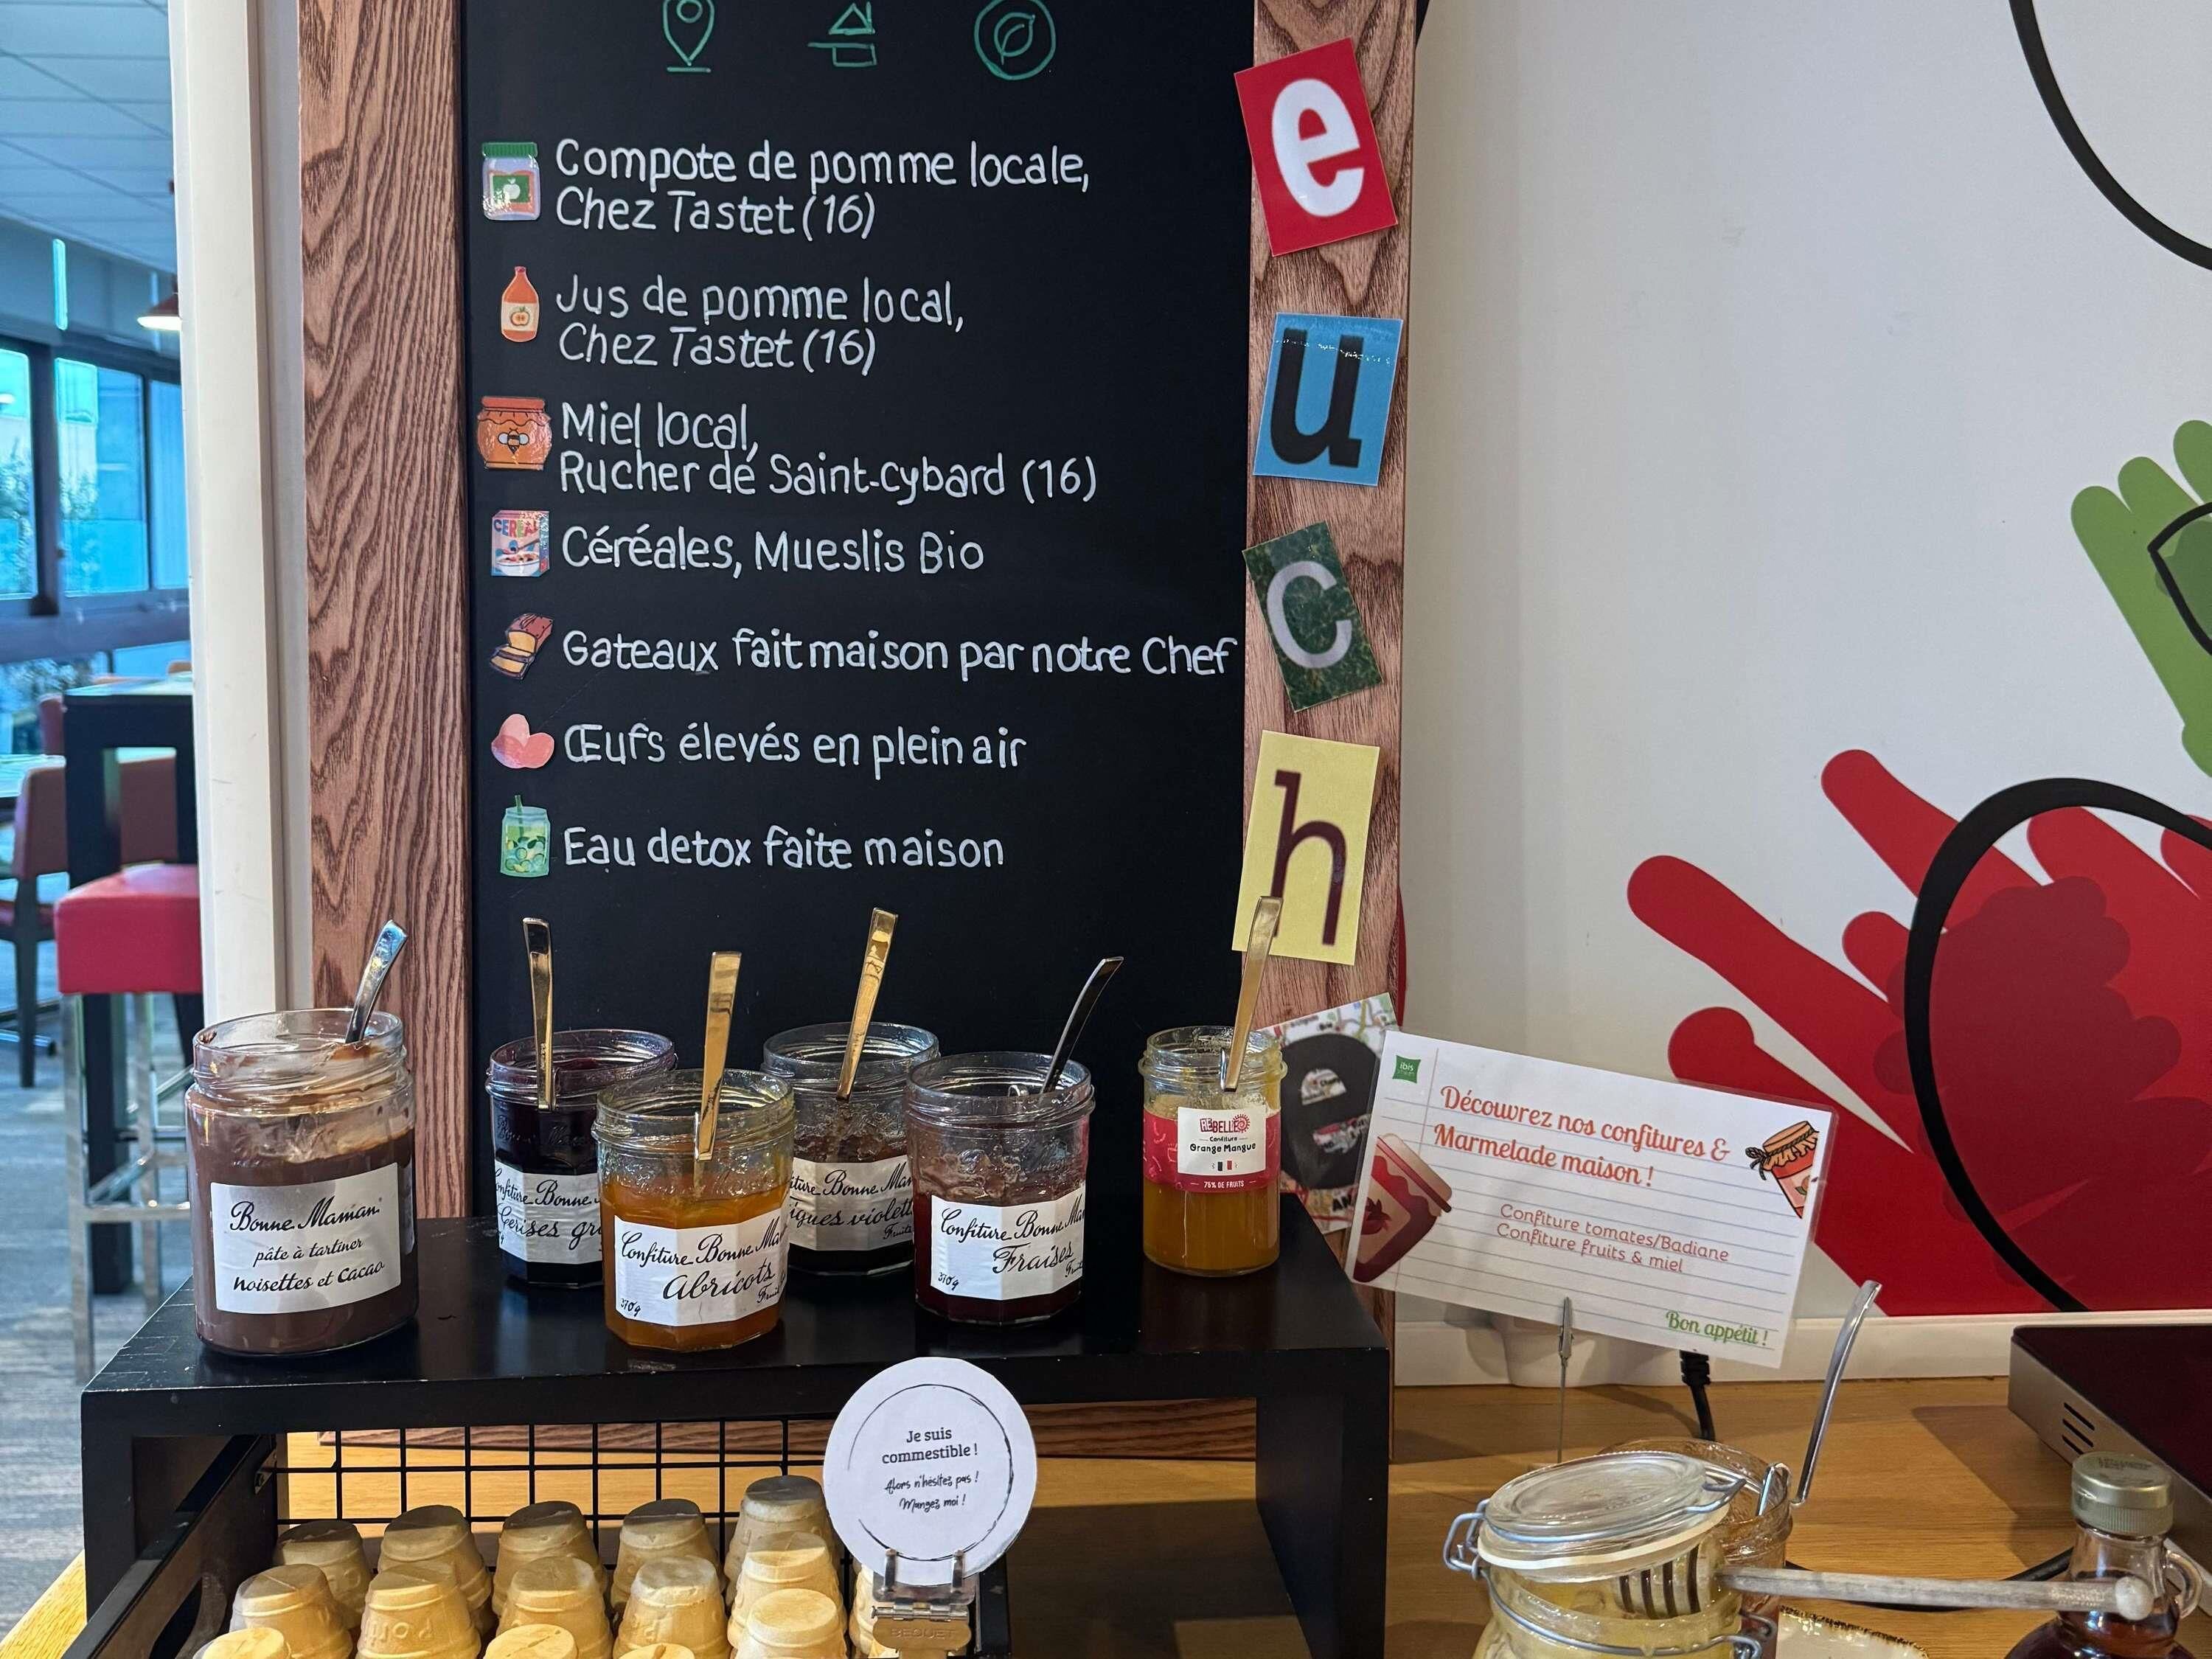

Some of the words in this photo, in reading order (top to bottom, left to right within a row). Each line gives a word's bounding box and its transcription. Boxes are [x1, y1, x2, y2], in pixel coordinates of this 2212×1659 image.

[1271, 77, 1366, 218] e
[556, 138, 737, 197] Compote
[748, 139, 797, 183] de
[810, 150, 957, 196] pomme
[970, 140, 1090, 193] locale,
[556, 186, 657, 232] Chez
[667, 189, 796, 235] Tastet
[802, 191, 876, 242] (16)
[556, 274, 629, 319] Jus
[642, 274, 689, 318] de
[702, 285, 848, 327] pomme
[863, 276, 964, 333] local,
[559, 321, 659, 367] Chez
[669, 326, 795, 369] Tastet
[802, 327, 876, 377] (16)
[1270, 327, 1365, 468] u
[562, 400, 641, 450] Miel
[657, 402, 759, 464] local,
[560, 448, 700, 495] Rucher
[1022, 456, 1097, 505] (16)
[562, 523, 743, 579] Céréales,
[754, 528, 906, 573] Mueslis
[919, 529, 985, 575] Bio
[562, 629, 720, 672] Gateaux
[731, 627, 804, 670] fait
[809, 629, 950, 671] maison
[959, 641, 1026, 683] par
[1032, 636, 1132, 674] notre
[1141, 634, 1239, 675] Chef
[563, 722, 666, 766] Œufs
[678, 721, 800, 764] élevés
[813, 732, 860, 768] en
[872, 725, 964, 782] plein
[972, 726, 1029, 769] air
[563, 826, 636, 867] Eau
[646, 827, 753, 869] detox
[762, 824, 854, 870] faite
[863, 827, 1006, 869] maison
[1270, 769, 1348, 947] h
[1399, 1061, 1414, 1071] ibis
[1199, 1117, 1240, 1133] REBELLE
[1440, 1085, 1553, 1128] Découvrez
[1557, 1113, 1596, 1136] nos
[1600, 1123, 1706, 1157] confitures
[1710, 1138, 1731, 1162] &
[1189, 1143, 1222, 1155] Orange
[1223, 1143, 1256, 1153] Mangue
[1433, 1123, 1558, 1168] Marmelade
[1561, 1155, 1643, 1186] maison
[535, 1178, 593, 1208] Bonne
[822, 1169, 880, 1196] Bonne
[1226, 1180, 1245, 1189] FRUITS
[229, 1200, 295, 1232] Bonne
[296, 1194, 380, 1230] Maman
[497, 1203, 561, 1238] Cerises
[940, 1207, 1013, 1243] Confiture
[1013, 1209, 1065, 1239] Bonne
[621, 1231, 695, 1268] Confiture
[695, 1233, 754, 1264] Bonne
[1496, 1222, 1576, 1251] Confiture
[1580, 1238, 1627, 1262] fruits
[1631, 1251, 1643, 1265] &
[1648, 1255, 1685, 1273] miel
[1500, 1203, 1580, 1232] Confiture
[1585, 1220, 1731, 1263] tomates/Badiane
[251, 1246, 290, 1268] pâte
[292, 1245, 305, 1260] à
[308, 1237, 364, 1259] tartiner
[992, 1240, 1074, 1274] Fraises
[232, 1272, 315, 1293] noisettes
[316, 1270, 335, 1288] et
[1665, 1310, 1702, 1334] Bon
[1703, 1323, 1759, 1345] appétit
[881, 1443, 971, 1464] commestible
[905, 1430, 922, 1444] Je
[924, 1427, 953, 1441] suis
[955, 1474, 973, 1489] pas
[898, 1497, 941, 1514] Mangez
[943, 1495, 959, 1507] moi
